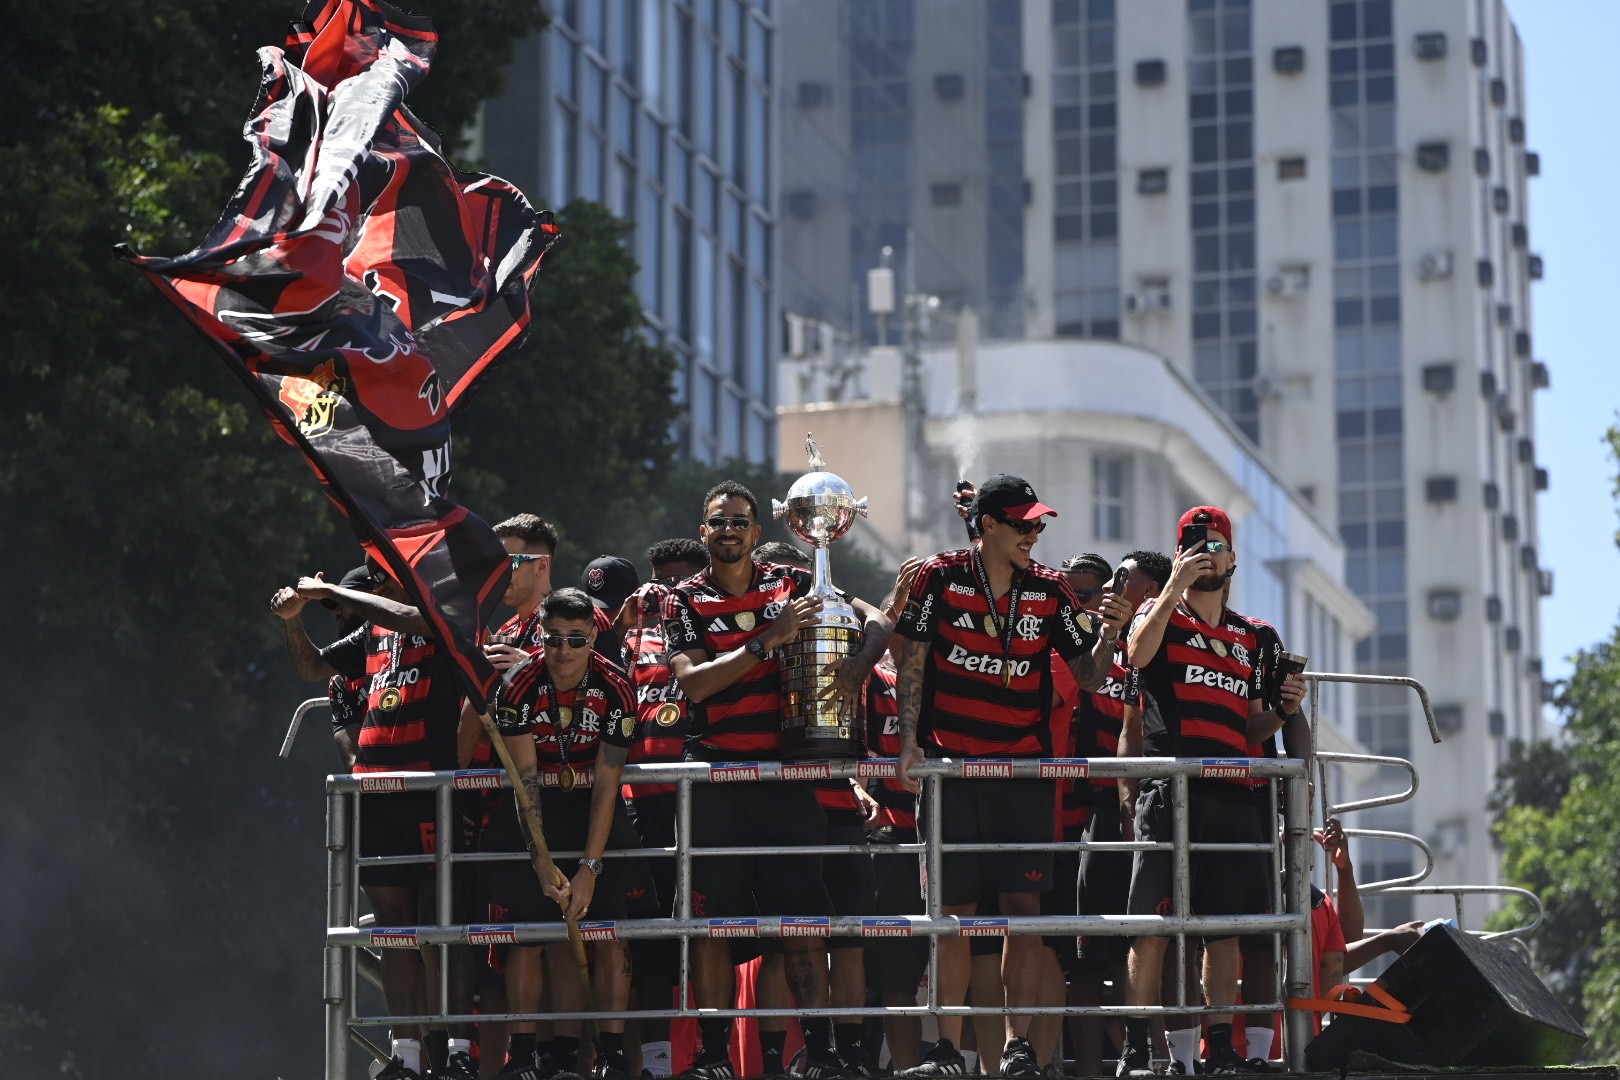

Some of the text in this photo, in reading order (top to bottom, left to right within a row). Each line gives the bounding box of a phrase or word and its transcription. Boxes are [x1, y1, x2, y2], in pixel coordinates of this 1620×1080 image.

[957, 585, 975, 596] BRB
[1029, 592, 1047, 602] BRB
[916, 593, 934, 633] Shopee
[681, 608, 698, 642] Shopee
[1060, 605, 1083, 646] Shopee
[947, 644, 1030, 677] Betano
[1185, 664, 1249, 699] Betan
[713, 769, 757, 782] BRAHMA
[783, 766, 828, 780] BRAHMA
[860, 764, 896, 777] BRAHM
[966, 765, 1010, 777] BRAHMA
[1042, 766, 1085, 778] BRAHMA
[1204, 768, 1246, 778] BRAHMA
[362, 778, 403, 791] BRAHMA
[457, 776, 499, 789] BRAHMA
[545, 772, 588, 785] BRMA
[580, 930, 614, 941] AHMA
[711, 928, 756, 938] BRAHMA
[782, 926, 827, 937] BRAHMA
[864, 928, 908, 937] BRAHMA
[962, 928, 1006, 937] BRAHMA
[373, 936, 415, 947] BRAHMA
[471, 934, 513, 944] BRAHMA
